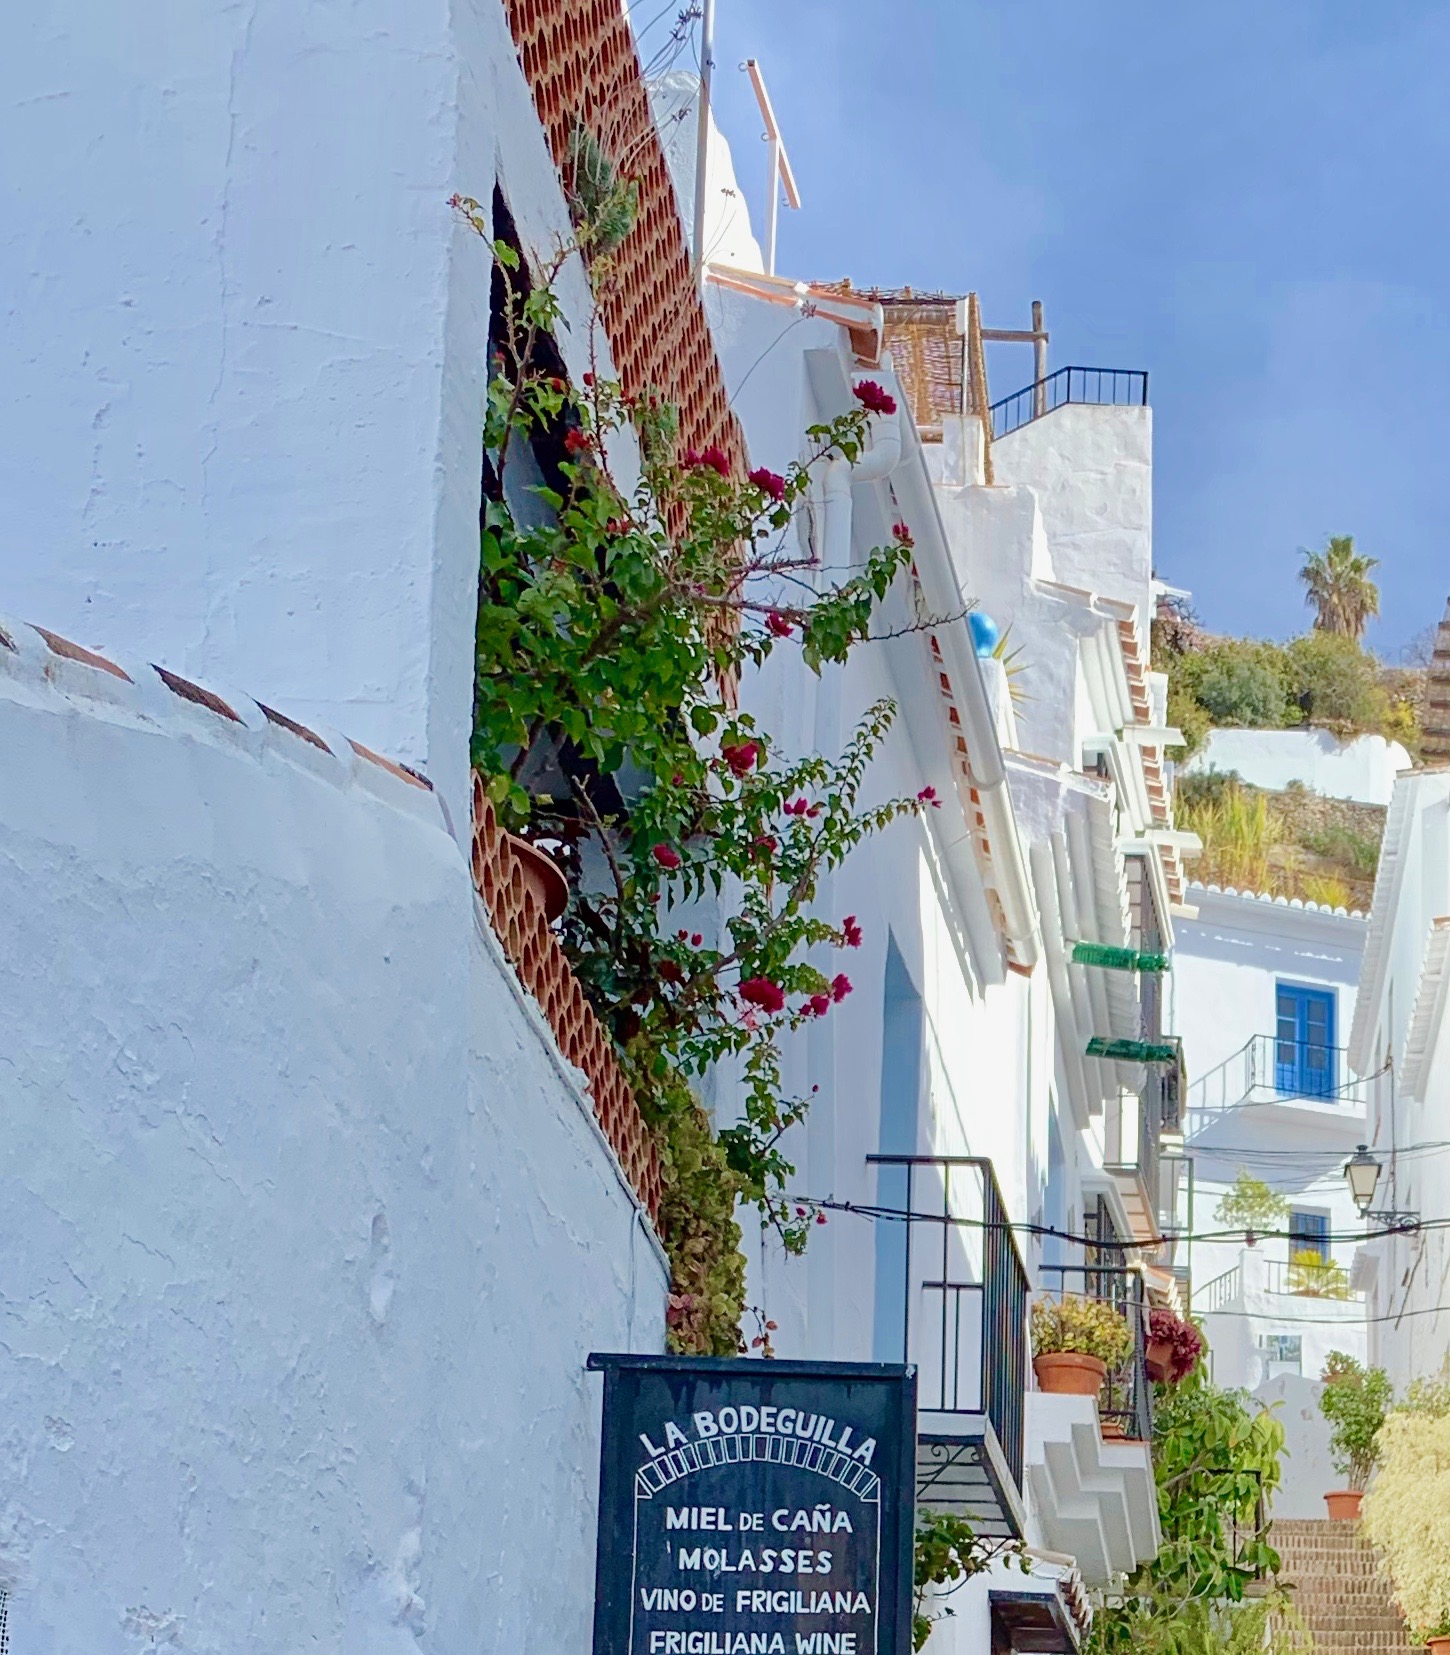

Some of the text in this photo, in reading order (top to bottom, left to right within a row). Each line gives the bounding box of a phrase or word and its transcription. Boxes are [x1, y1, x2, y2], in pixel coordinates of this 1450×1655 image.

[640, 1406, 876, 1465] LA BODEGUILLA
[666, 1503, 853, 1533] MIEL DE CAÑA
[678, 1548, 833, 1574] MOLASSES
[640, 1588, 871, 1613] VINO DE FRIGILIANA
[650, 1631, 857, 1655] FRIGILIANA WINE
